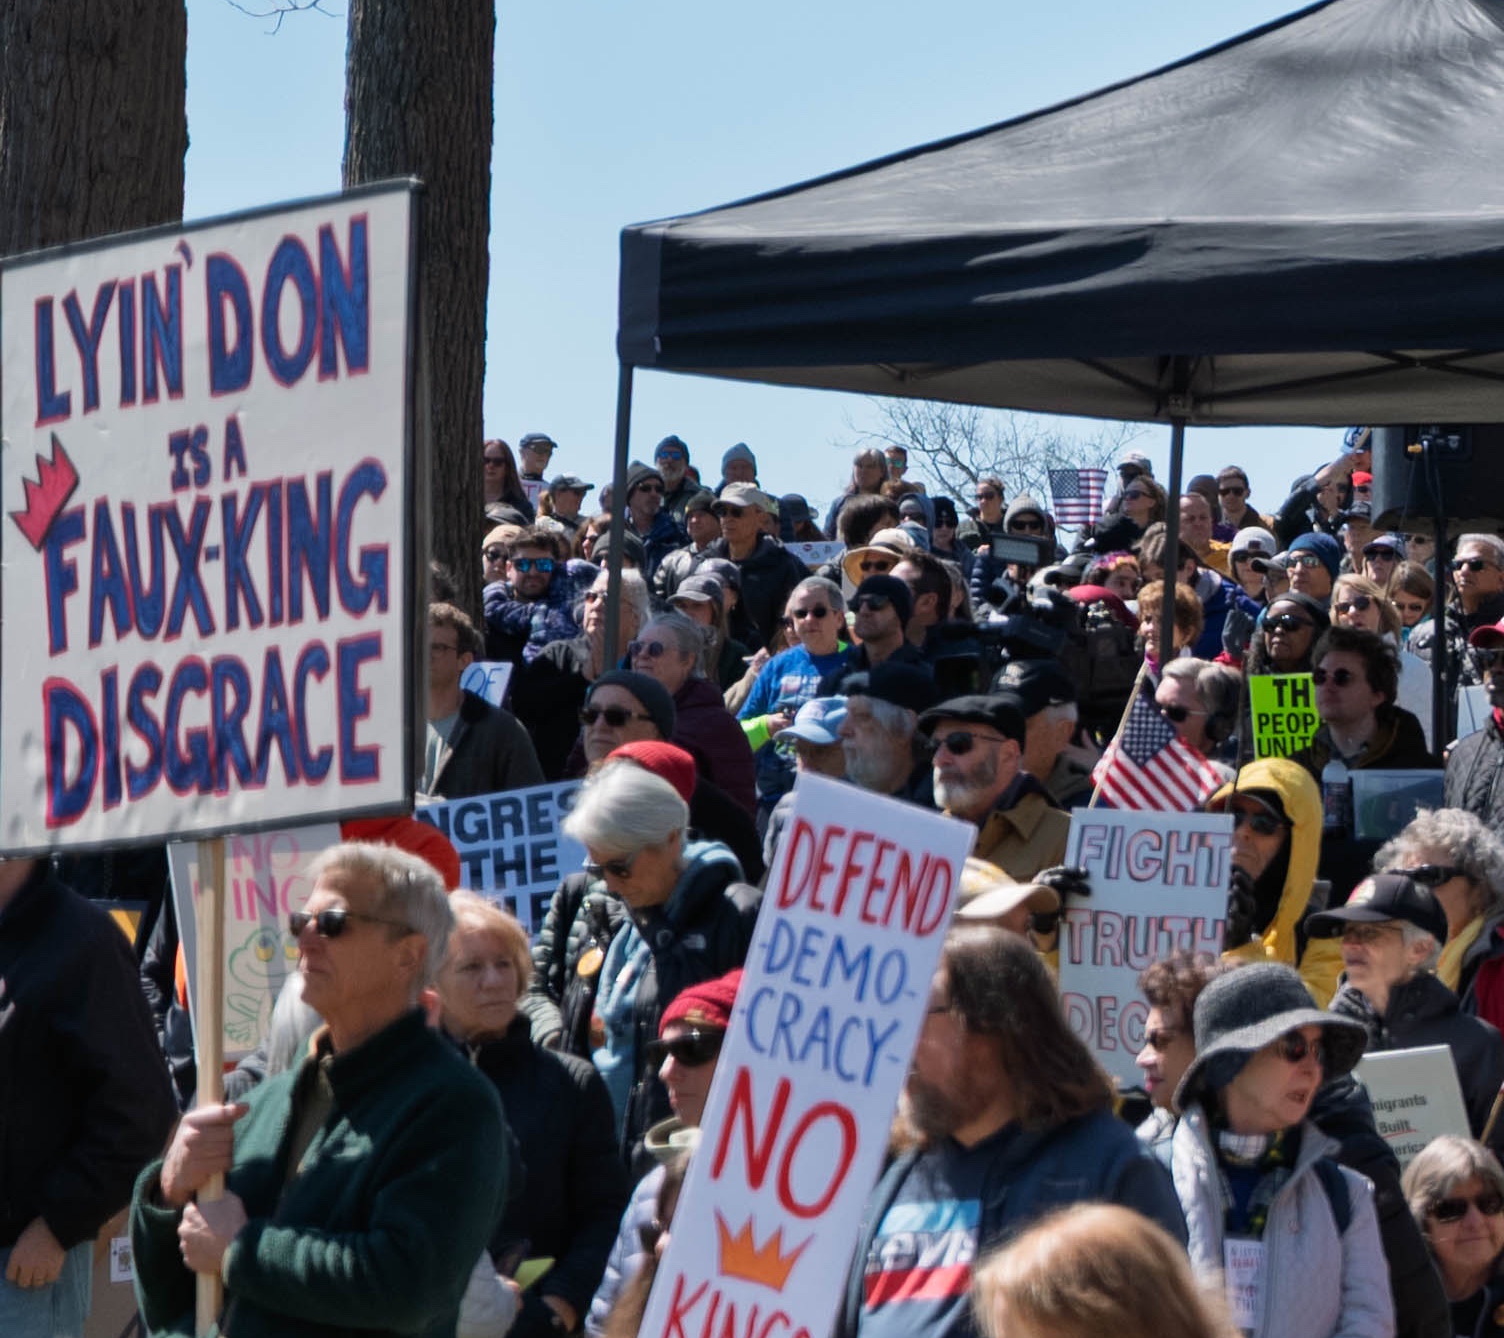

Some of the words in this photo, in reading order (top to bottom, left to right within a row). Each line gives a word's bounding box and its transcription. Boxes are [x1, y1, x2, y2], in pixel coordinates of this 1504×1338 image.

[35, 239, 193, 428] LYIN'
[205, 212, 369, 398] DON
[169, 423, 210, 492] IS
[223, 414, 247, 482] A
[43, 456, 390, 657] FAUX-KING
[1257, 712, 1316, 734] PEOP
[1272, 678, 1310, 707] TH
[43, 630, 383, 830] DISGRACE
[1257, 736, 1310, 757] UNIT
[416, 788, 585, 844] NGRE
[231, 832, 300, 872] NO
[462, 839, 560, 891] THE
[777, 818, 953, 938] DEFEND
[1077, 824, 1232, 887] FIGHT
[1066, 908, 1226, 970] TRUTH
[1063, 992, 1150, 1055] DEC
[711, 1067, 857, 1219] NO
[1380, 1120, 1411, 1133] Built
